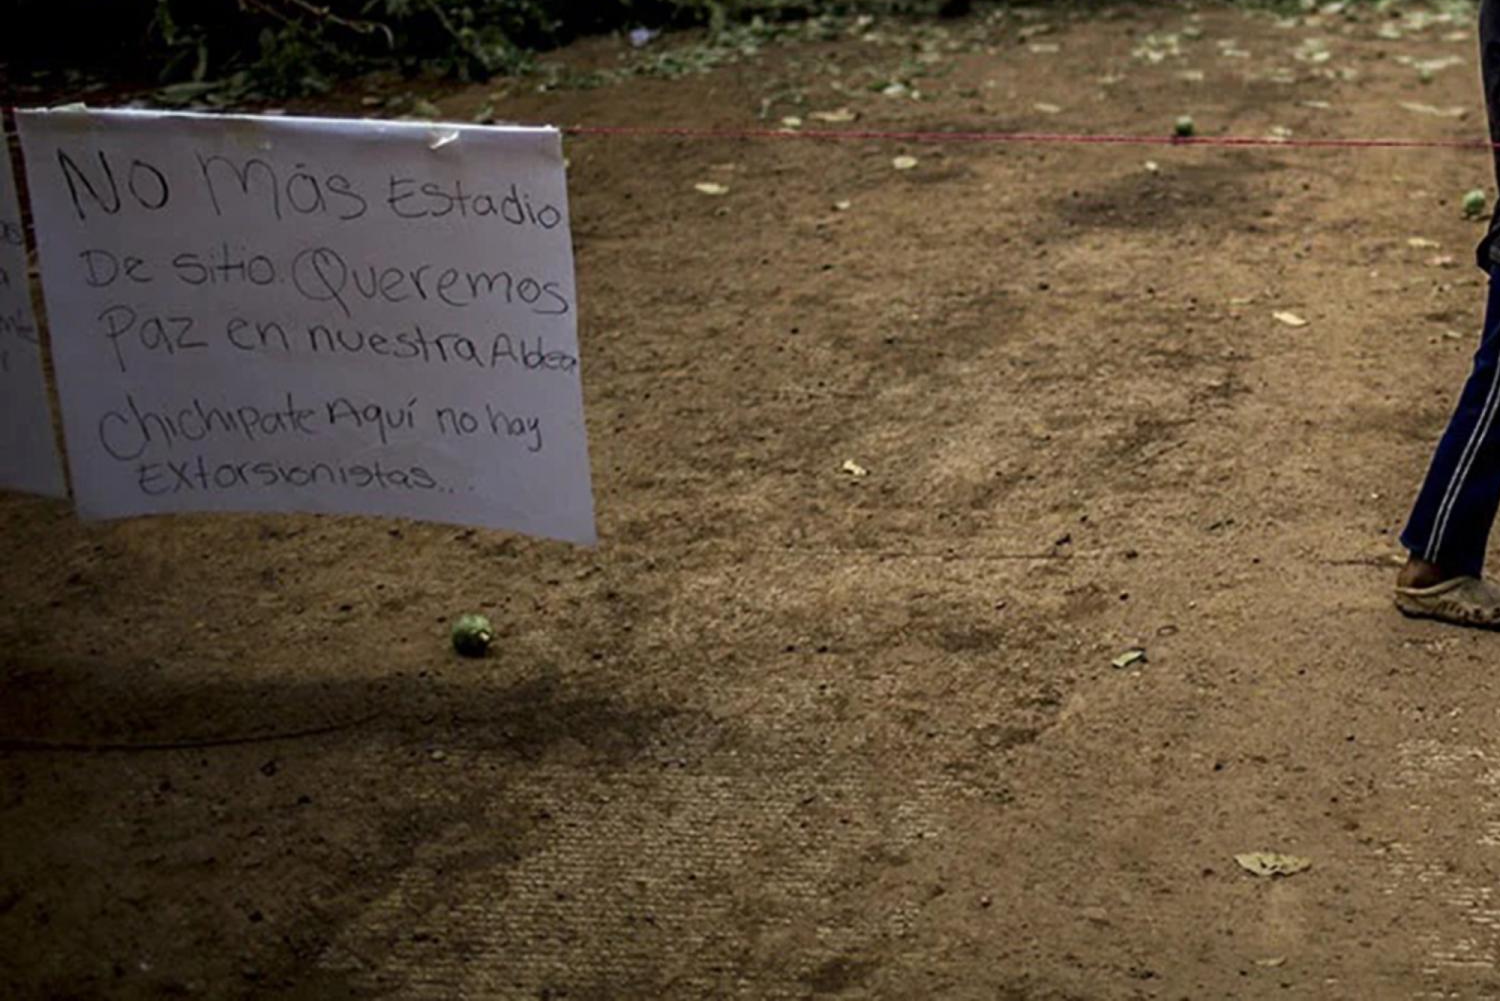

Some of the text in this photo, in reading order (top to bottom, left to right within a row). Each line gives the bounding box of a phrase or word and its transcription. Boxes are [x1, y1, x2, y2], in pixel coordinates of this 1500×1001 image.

[387, 173, 561, 229] Estadio
[78, 248, 153, 288] De
[291, 247, 569, 318] Queremos
[97, 304, 578, 374] Paz en nuestra Aldea
[99, 391, 543, 461] Chichipate Aquí no hay
